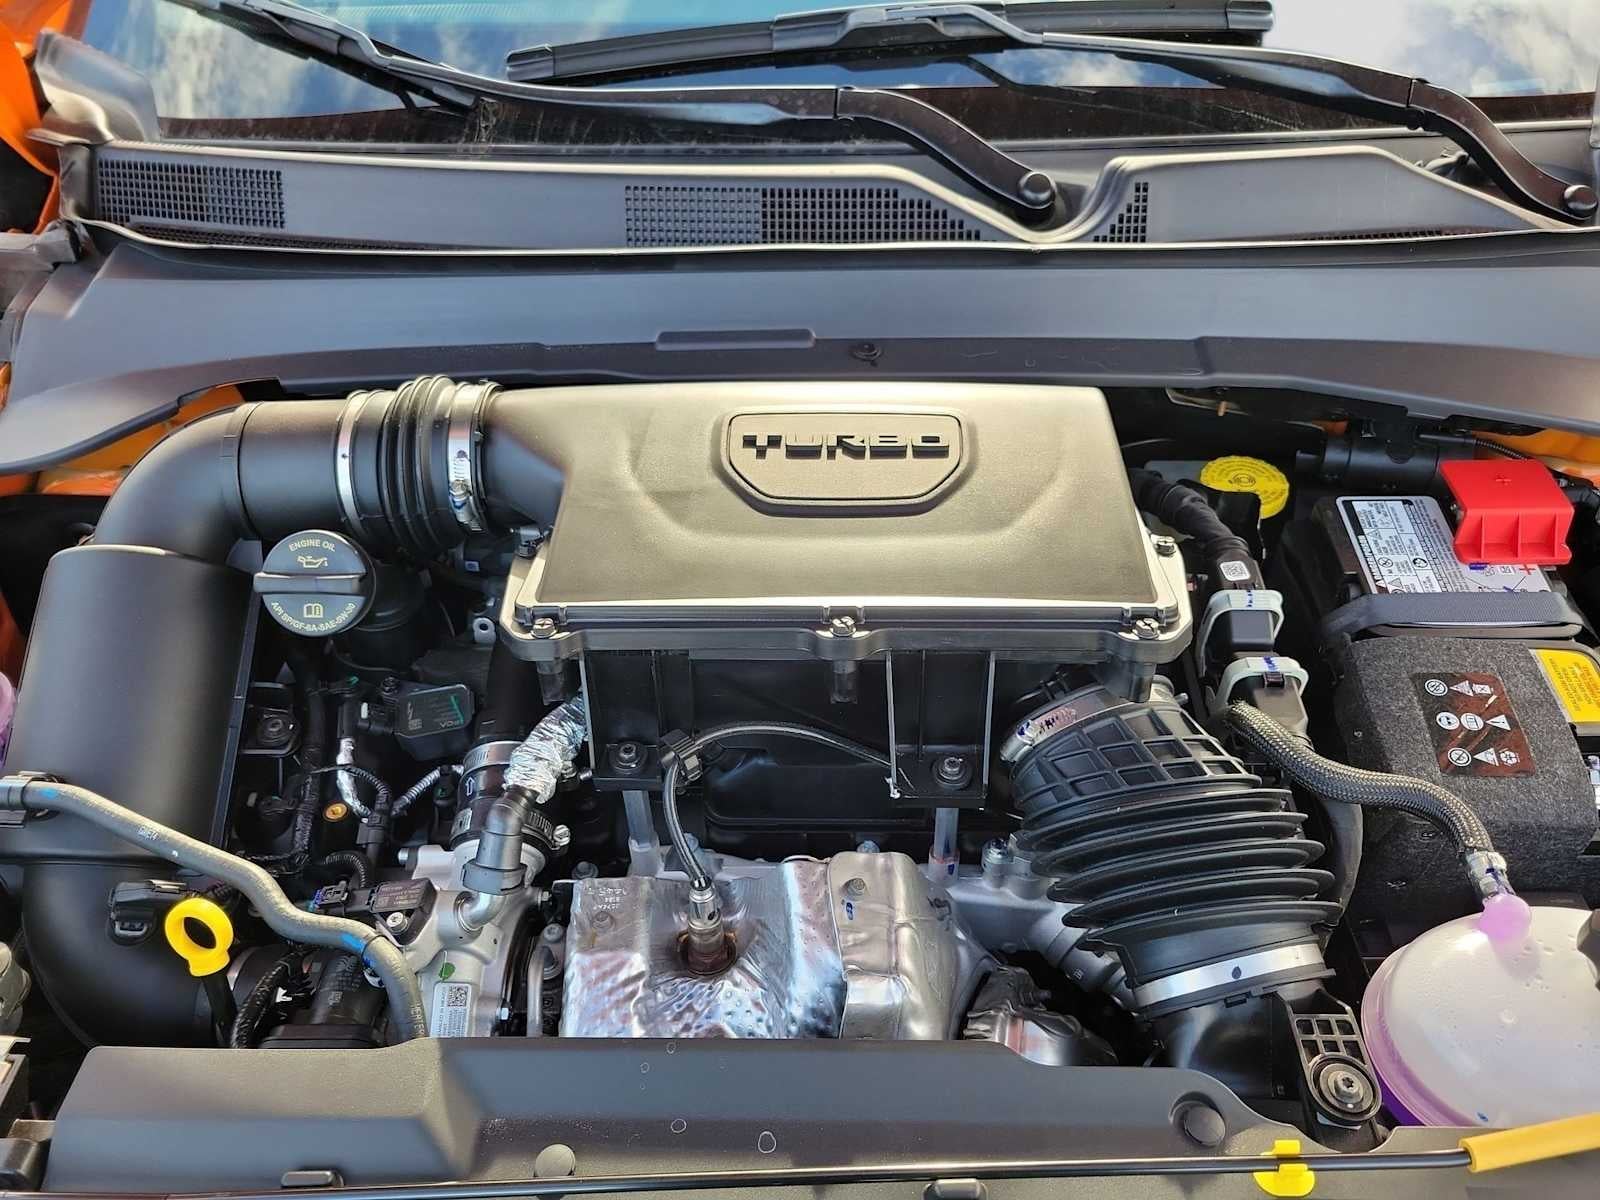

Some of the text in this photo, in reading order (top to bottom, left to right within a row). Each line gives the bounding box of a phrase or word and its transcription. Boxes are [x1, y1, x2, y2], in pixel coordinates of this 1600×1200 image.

[741, 432, 950, 460] TURBO
[288, 539, 336, 552] ENGINE OIL
